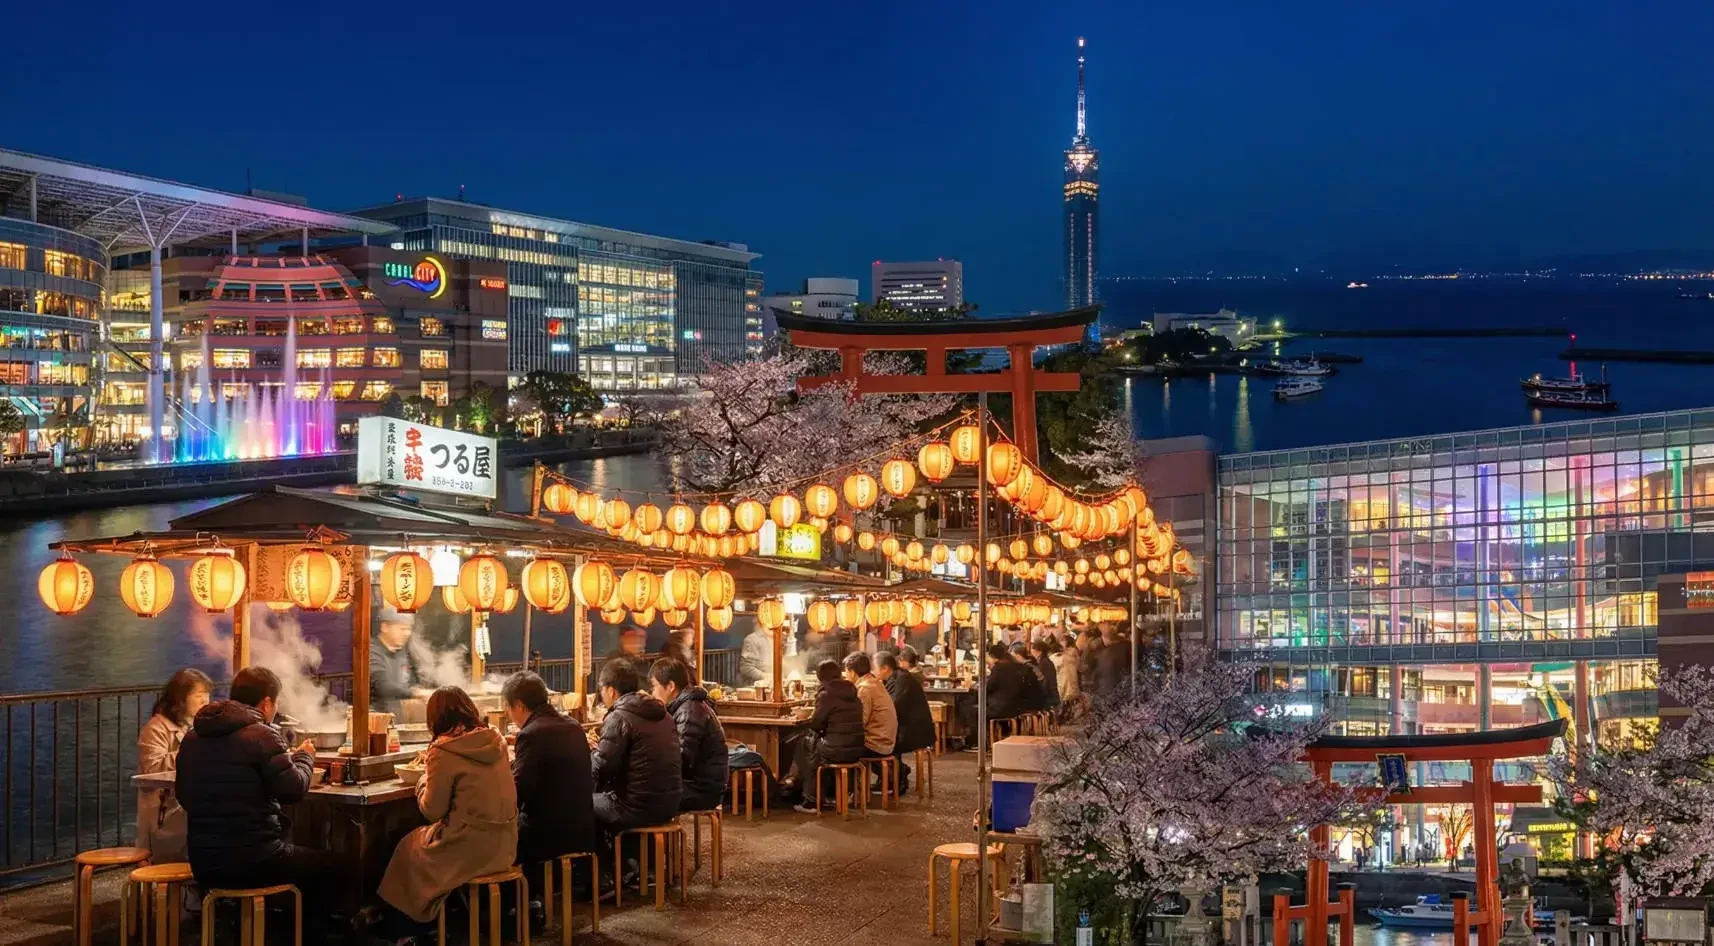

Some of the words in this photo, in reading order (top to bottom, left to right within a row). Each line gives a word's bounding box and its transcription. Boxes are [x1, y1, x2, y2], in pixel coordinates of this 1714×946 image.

[416, 265, 436, 281] CITY
[430, 443, 492, 480] つる屋
